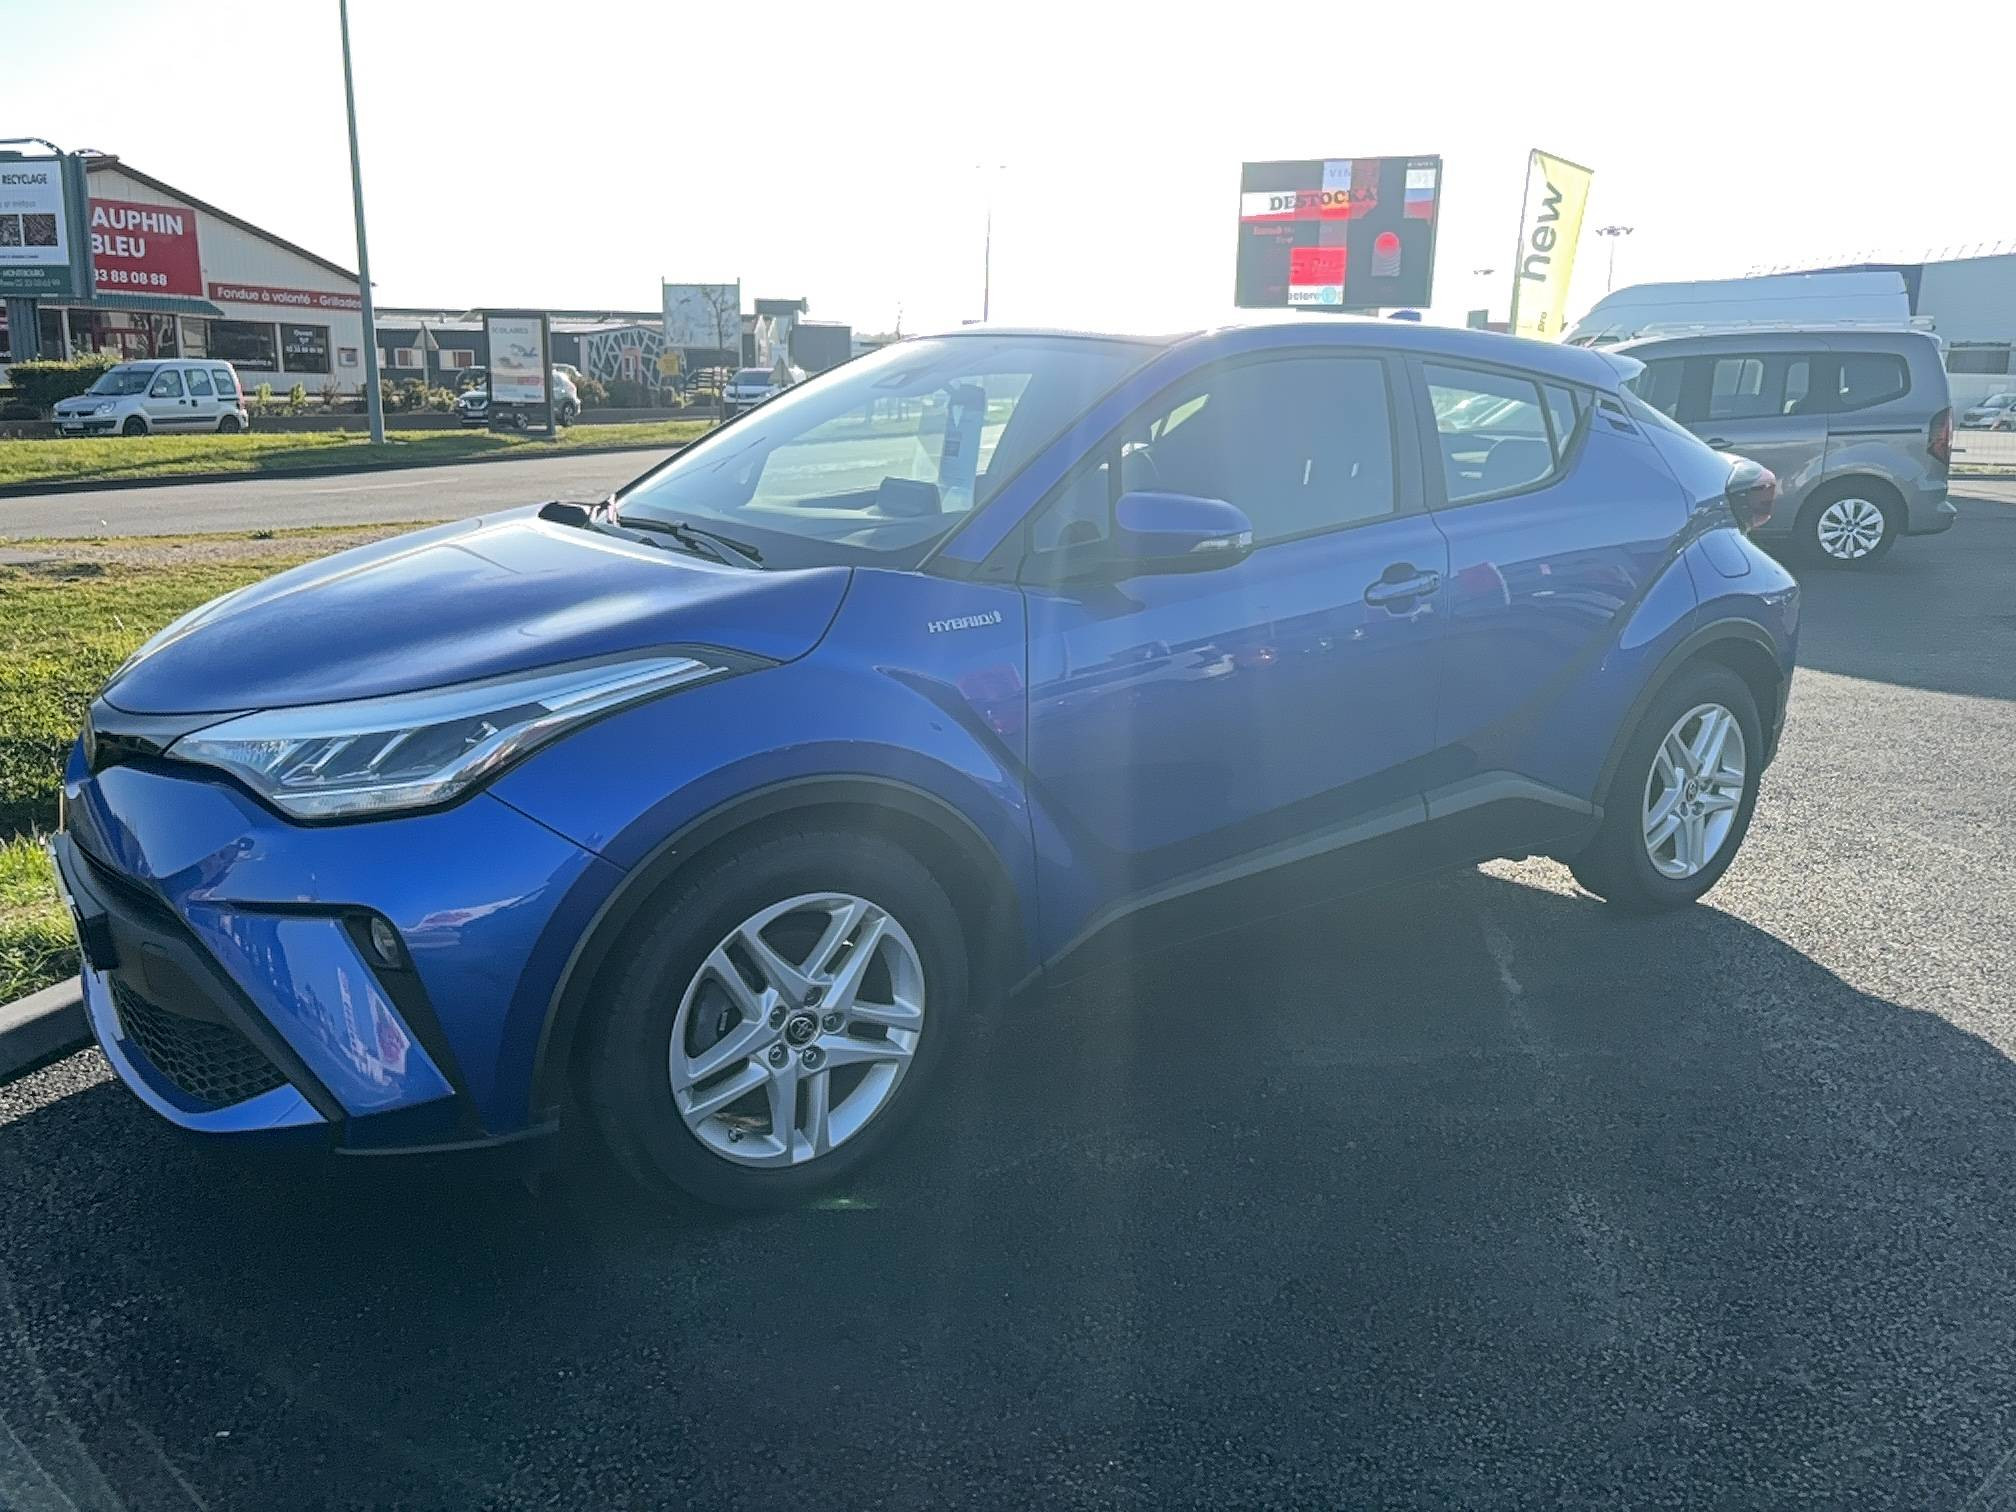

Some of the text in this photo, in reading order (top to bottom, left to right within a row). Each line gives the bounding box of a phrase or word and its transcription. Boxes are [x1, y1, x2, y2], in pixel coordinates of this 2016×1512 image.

[2, 173, 48, 185] RECYCLAGE
[1521, 181, 1563, 282] new
[91, 233, 146, 258] BLEU
[111, 269, 128, 283] 88
[130, 271, 148, 285] 08
[150, 272, 168, 287] 88
[217, 286, 259, 301] Fondue
[262, 289, 270, 301] à
[928, 613, 993, 634] HYBRID
